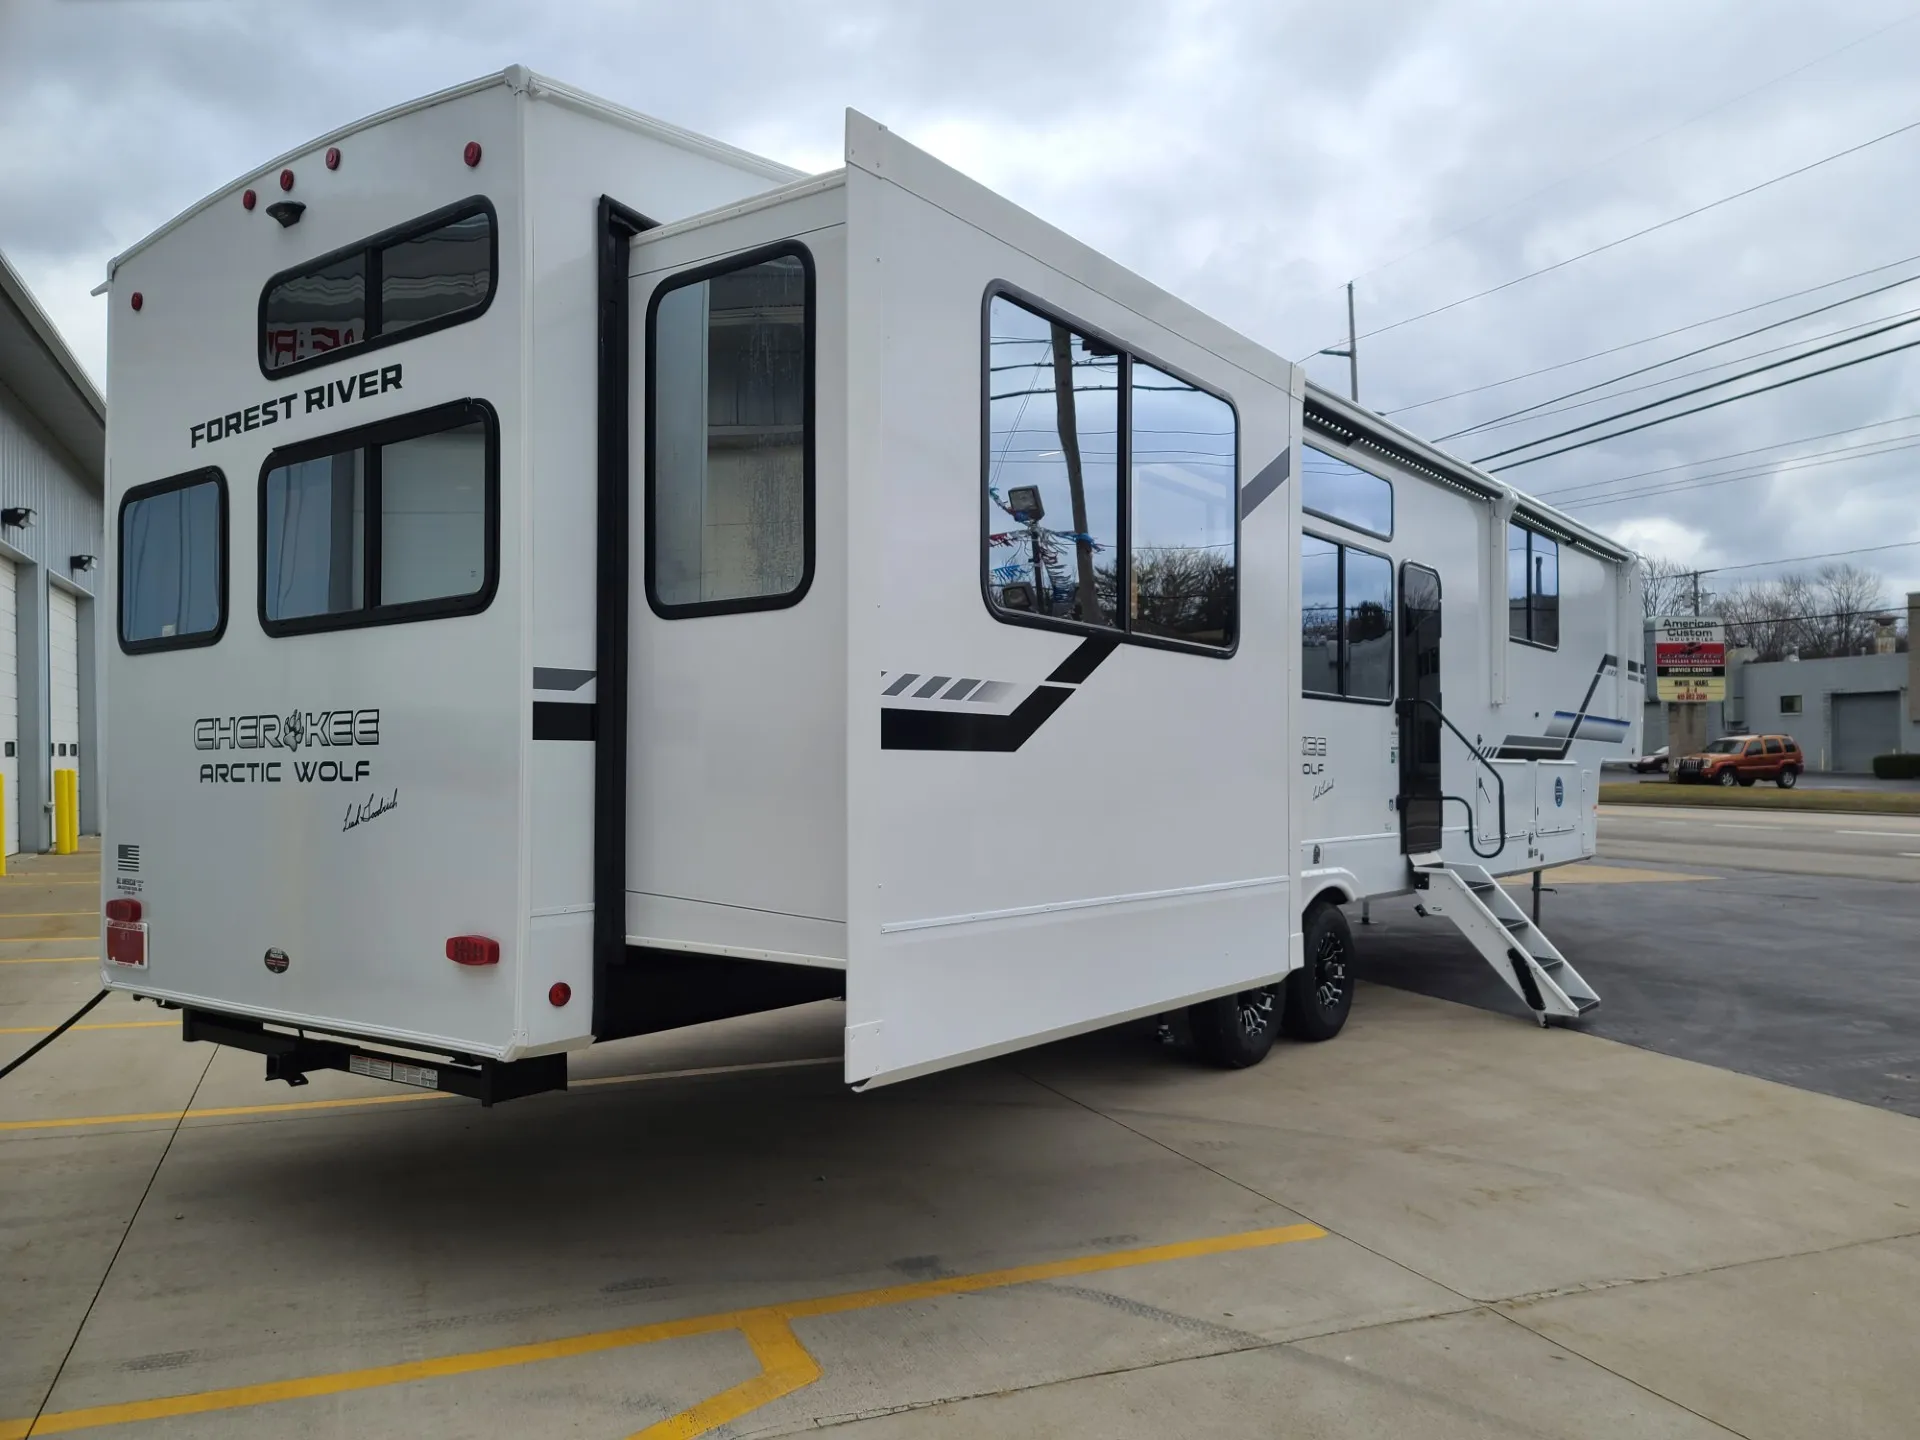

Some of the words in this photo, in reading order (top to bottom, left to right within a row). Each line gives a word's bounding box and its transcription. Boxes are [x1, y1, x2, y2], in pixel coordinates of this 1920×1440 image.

[189, 393, 298, 449] FOREST
[304, 363, 403, 414] RIVER
[1663, 619, 1717, 627] American
[200, 762, 282, 783] ARCTIC
[294, 760, 370, 783] WOLF
[1302, 763, 1324, 775] OLF
